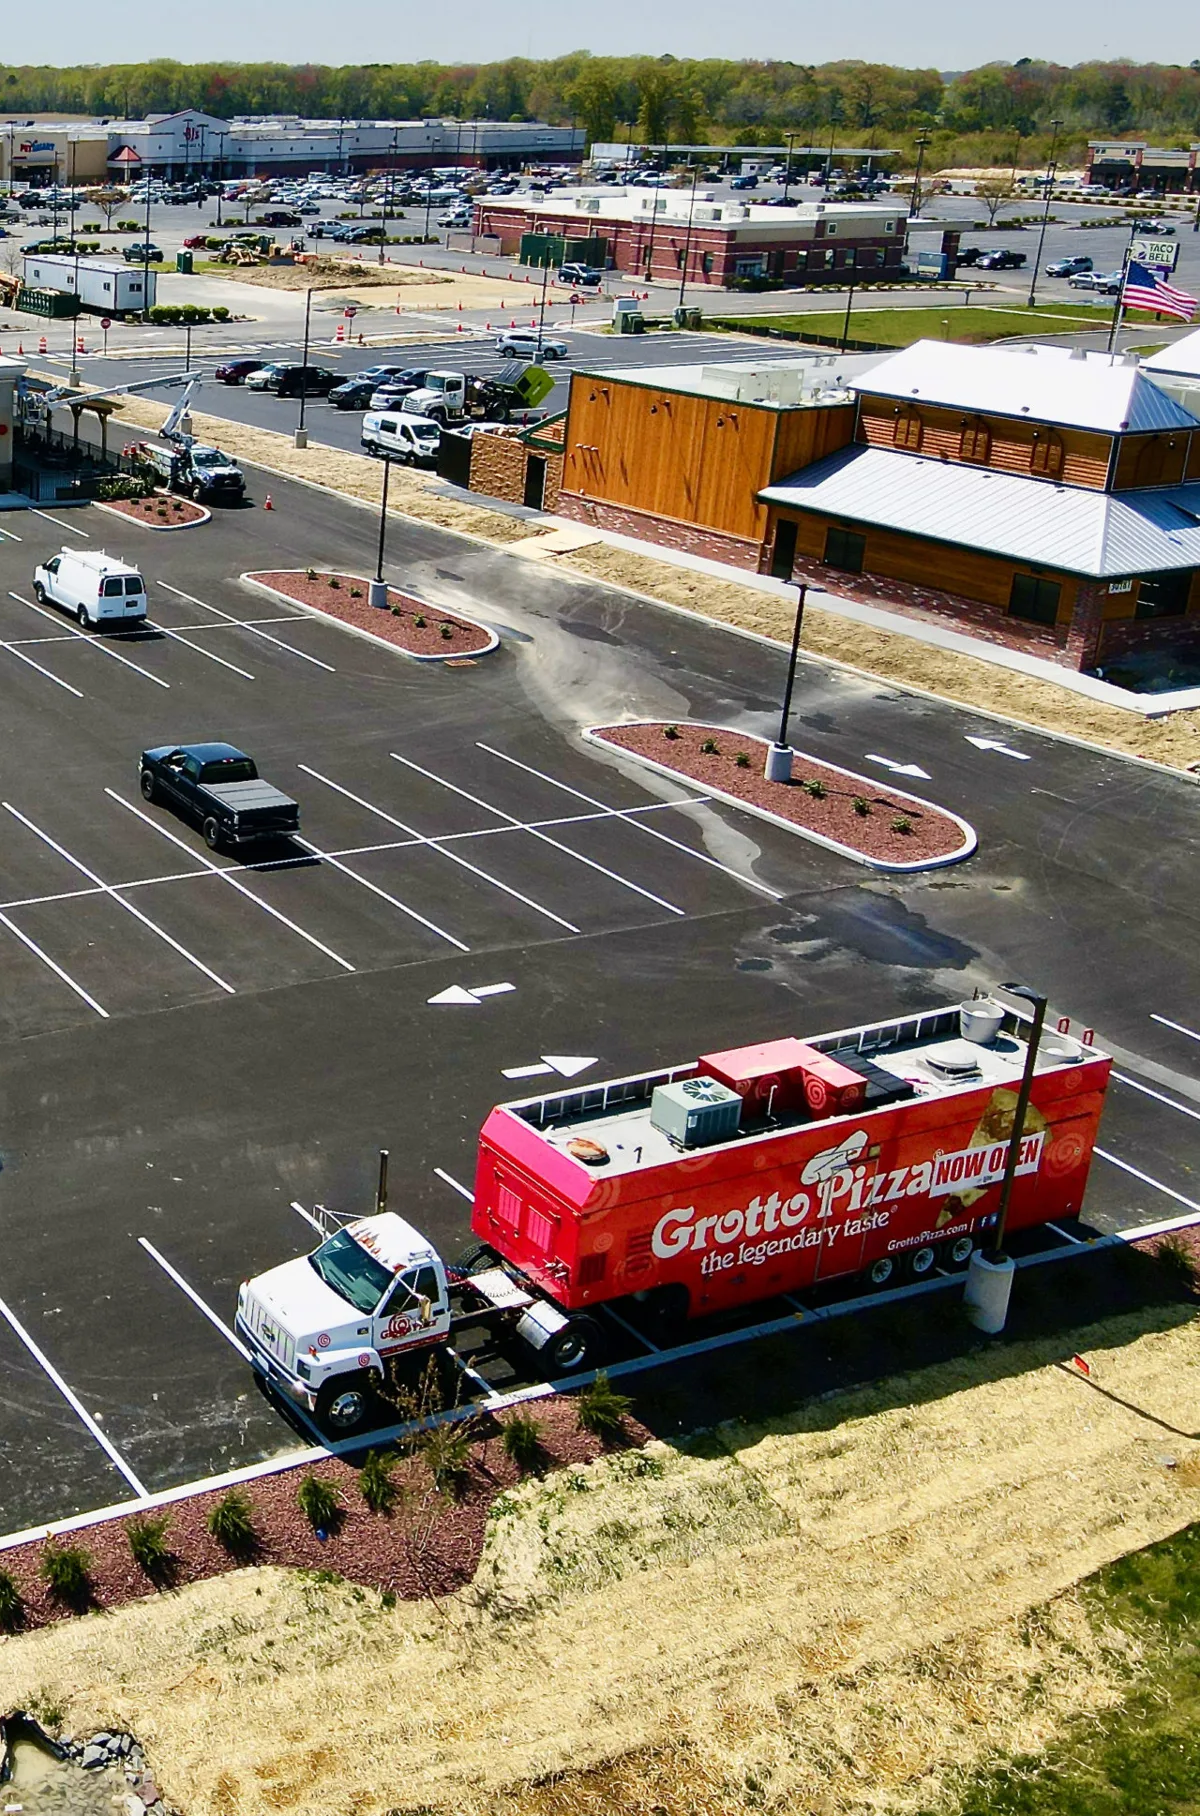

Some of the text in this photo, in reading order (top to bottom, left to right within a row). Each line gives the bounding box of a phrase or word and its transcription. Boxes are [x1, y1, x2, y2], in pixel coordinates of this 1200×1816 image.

[1148, 252, 1171, 263] BELL
[1149, 243, 1174, 253] TACO
[935, 1151, 987, 1186] NOW
[652, 1160, 935, 1259] Grotto Pizza
[700, 1210, 889, 1276] the legendary taste
[887, 1222, 968, 1251] GrottoPizza.com
